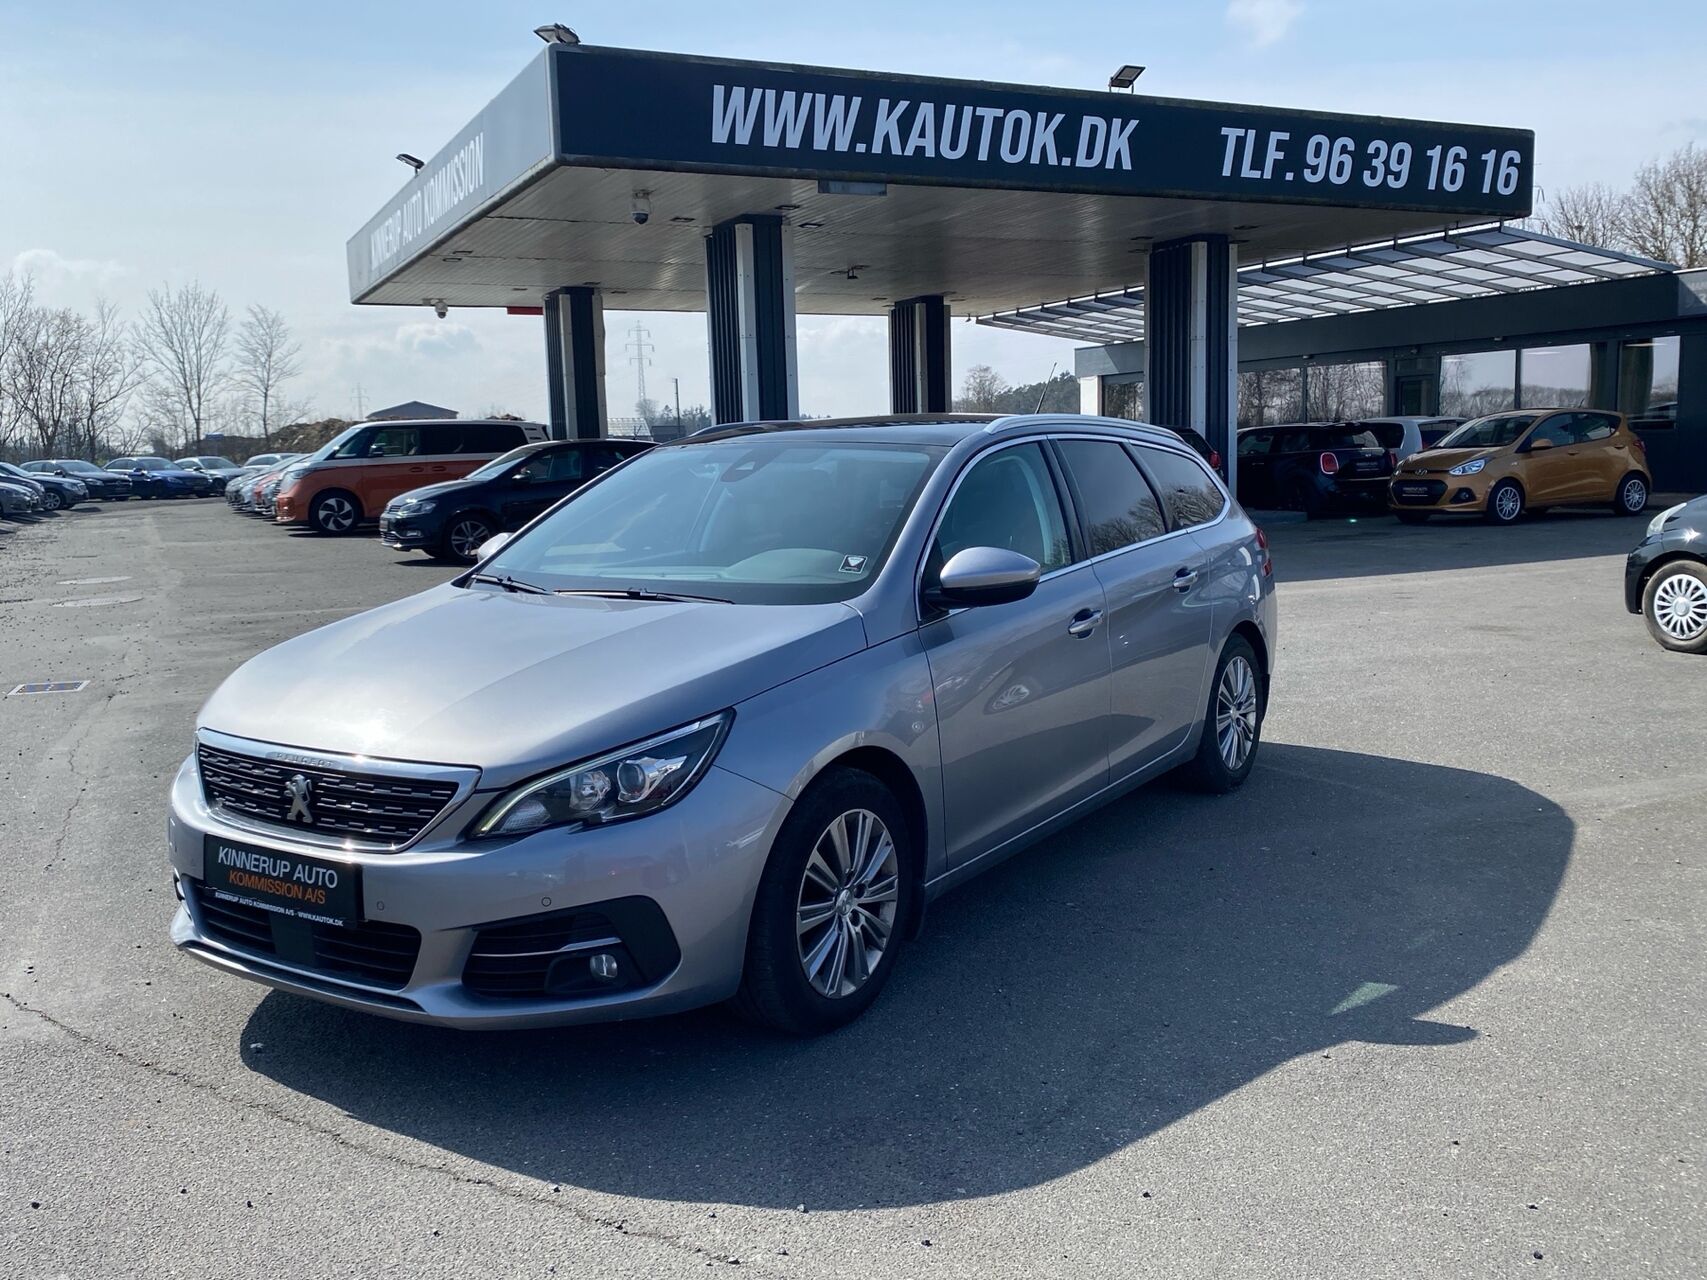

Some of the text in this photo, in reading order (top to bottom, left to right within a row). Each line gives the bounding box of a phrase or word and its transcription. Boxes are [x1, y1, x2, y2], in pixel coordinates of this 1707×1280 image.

[711, 84, 1139, 170] WWW.KAUTOK.DK
[402, 190, 422, 246] AUTO
[423, 131, 484, 230] KOMMISSION
[1220, 126, 1522, 196] TLF. 96 39 16 16
[218, 846, 338, 889] KINNERUP AUTO
[228, 869, 326, 905] KOMMISSION A/S
[239, 897, 253, 906] AUTO
